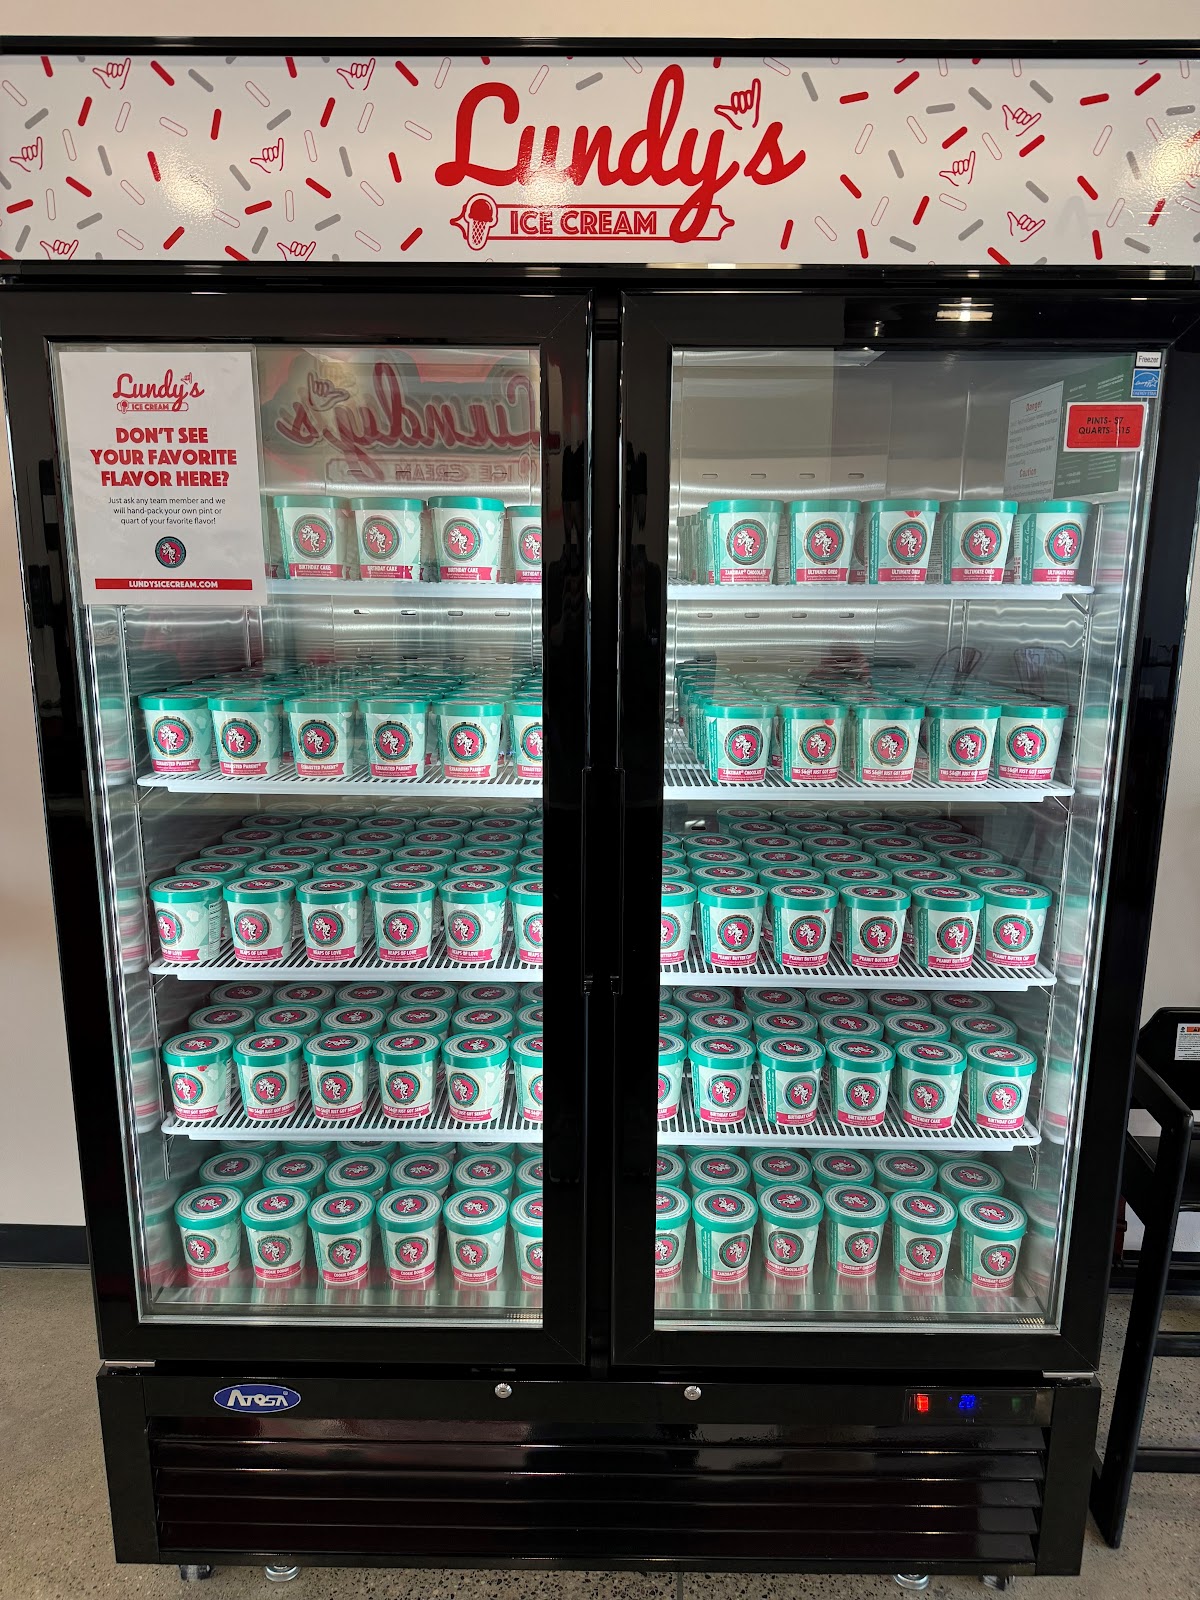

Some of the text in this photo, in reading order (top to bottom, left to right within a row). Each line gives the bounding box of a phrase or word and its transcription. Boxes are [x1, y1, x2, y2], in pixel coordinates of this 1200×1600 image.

[434, 63, 806, 243] Lundy's
[510, 210, 657, 235] ICE CREAM
[112, 369, 205, 412] Lundy's
[115, 428, 208, 443] DON'T SEE
[90, 450, 237, 465] YOUR FAVORITE
[101, 471, 230, 486] FLAVOR HERE?
[127, 507, 164, 515] hand-pack
